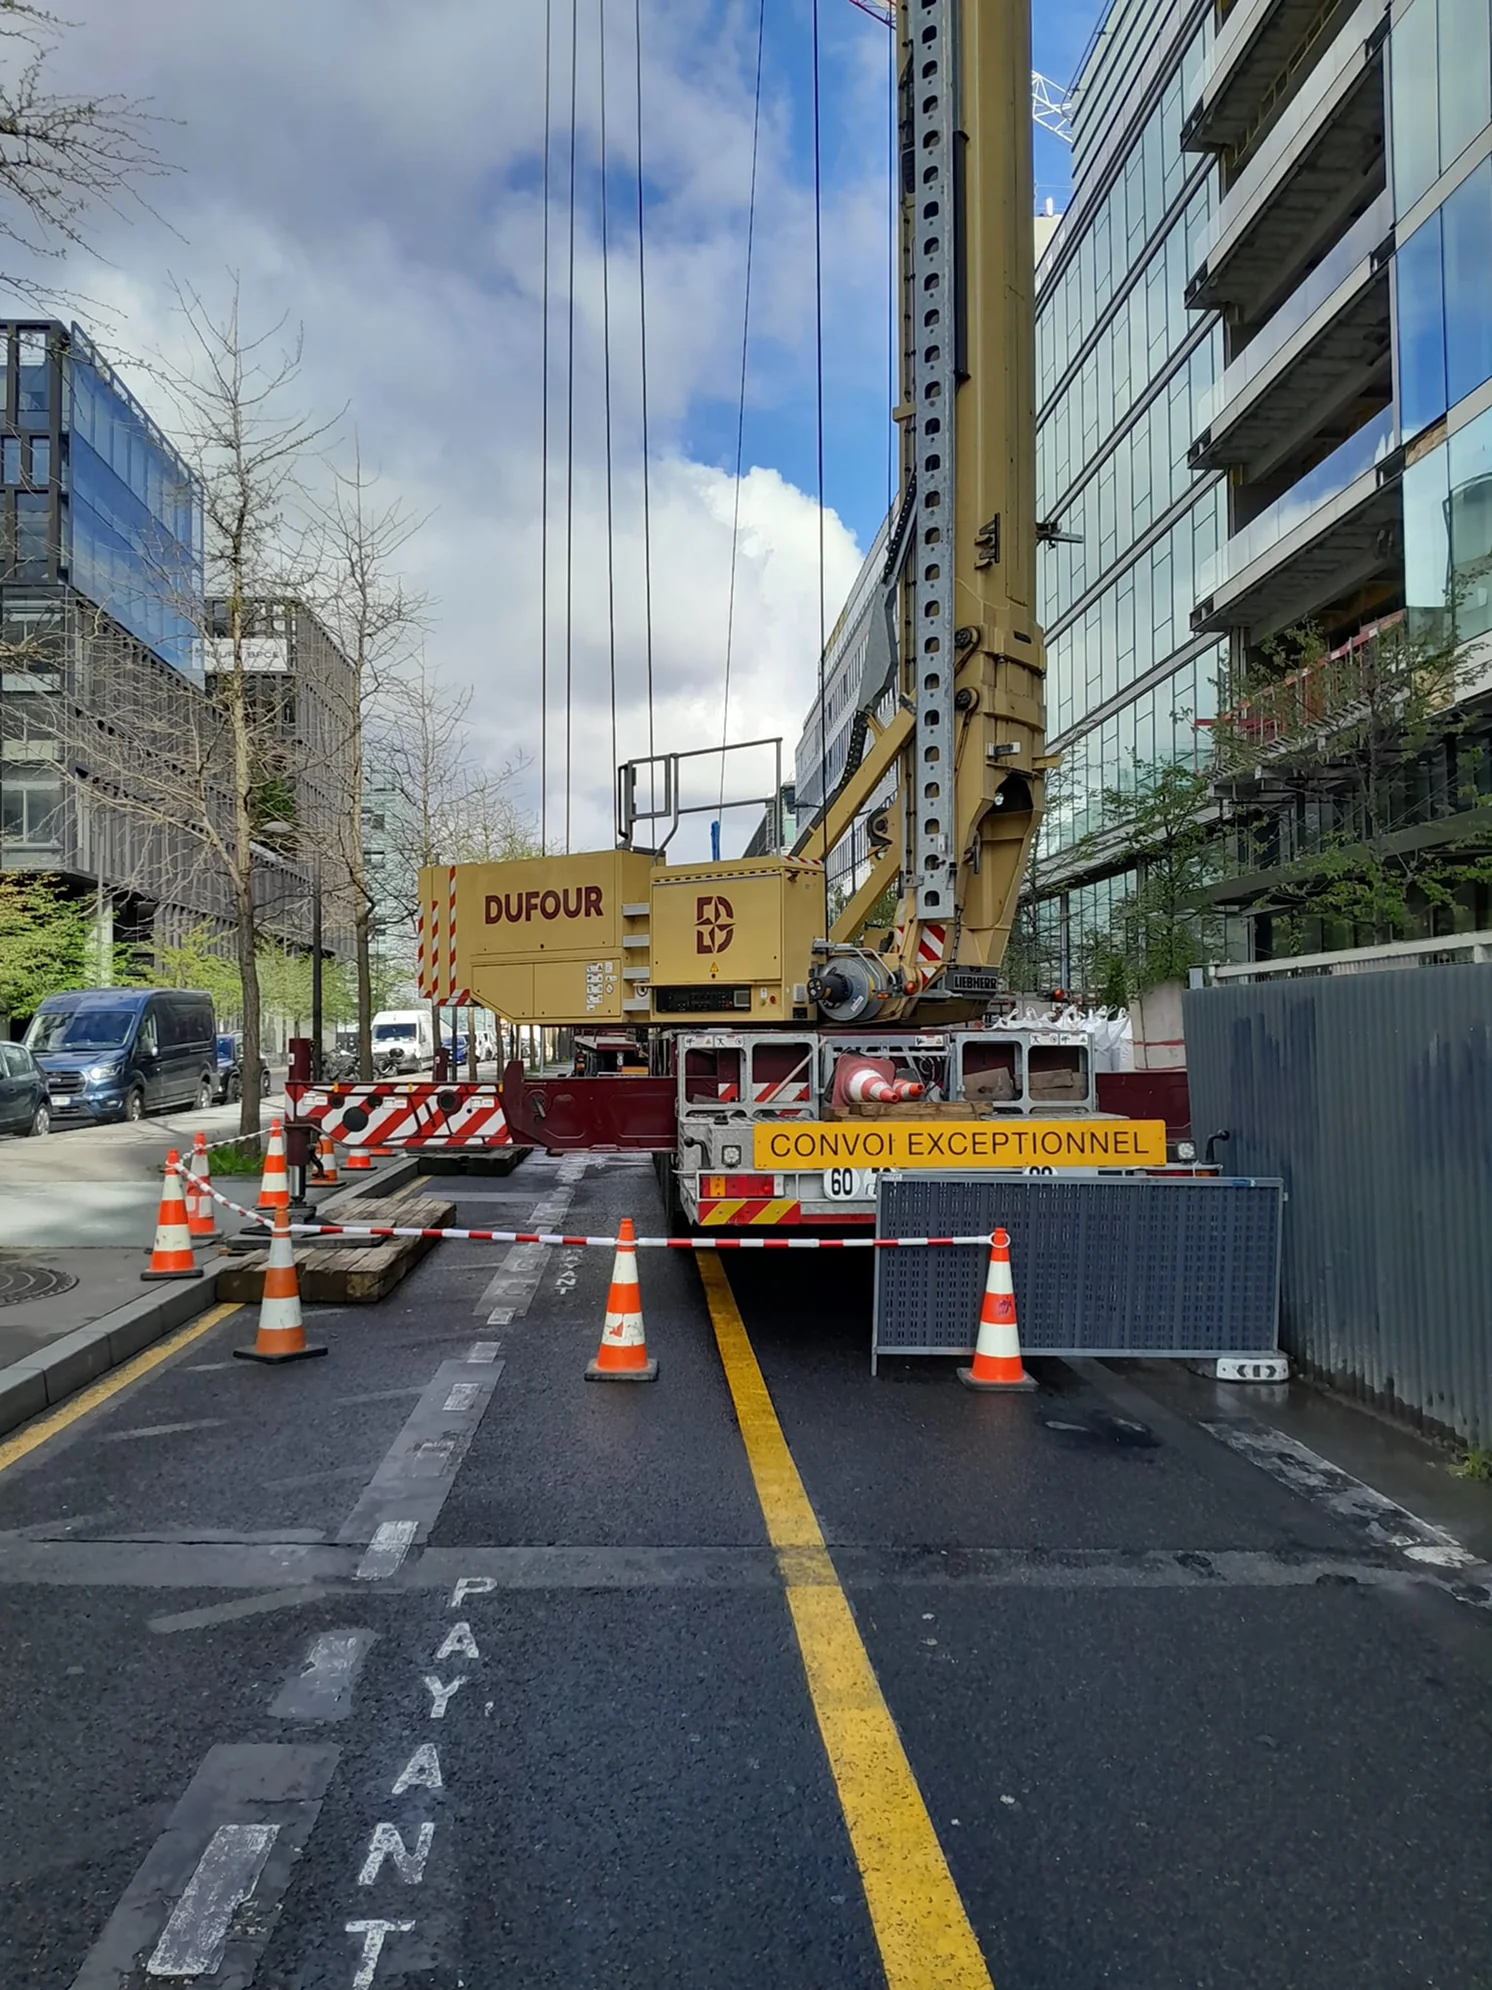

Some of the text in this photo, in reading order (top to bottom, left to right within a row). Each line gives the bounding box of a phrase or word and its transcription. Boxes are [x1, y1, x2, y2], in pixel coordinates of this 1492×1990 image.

[194, 651, 279, 659] ROUP BPCE
[485, 885, 604, 925] DUFOUR
[954, 975, 997, 989] LIEBHERR
[770, 1131, 1150, 1157] CONVOI EXCEPTIONNEL
[831, 1168, 853, 1196] 60
[345, 1577, 498, 1990] PAYANT
